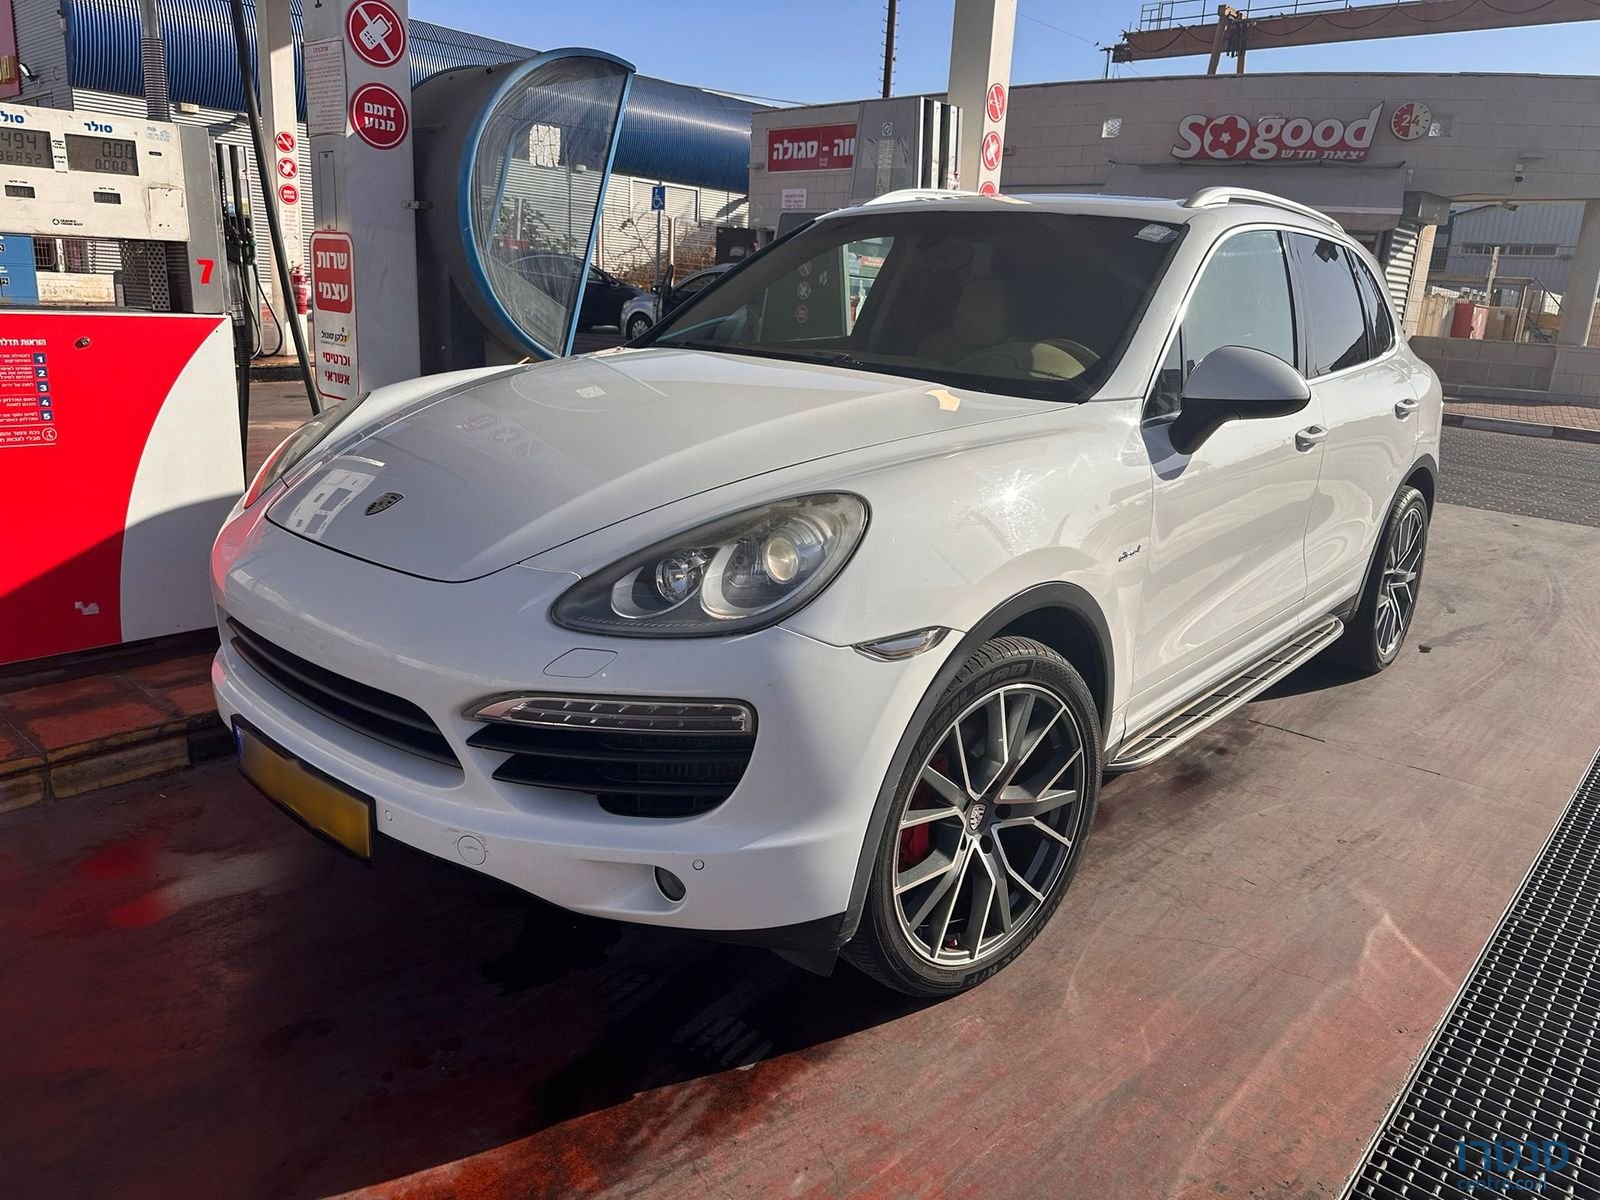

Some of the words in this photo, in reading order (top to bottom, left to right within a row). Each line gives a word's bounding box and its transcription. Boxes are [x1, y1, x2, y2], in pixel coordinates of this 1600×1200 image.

[363, 102, 396, 118] דומם
[0, 110, 25, 124] סול
[1401, 114, 1420, 127] 24
[84, 121, 113, 134] סולר
[363, 116, 397, 132] מנוע
[773, 139, 818, 160] סגולה
[1280, 149, 1317, 159] חדש
[1321, 150, 1365, 160] יצאת
[316, 251, 348, 270] שרות
[196, 258, 215, 285] 7
[318, 281, 349, 303] עצמי
[20, 338, 47, 346] הוראות
[322, 351, 351, 368] וכרטיסי
[38, 369, 46, 377] 2
[324, 370, 351, 386] אשראי
[40, 384, 48, 392] 3
[41, 399, 50, 407] 4
[43, 412, 51, 420] 5
